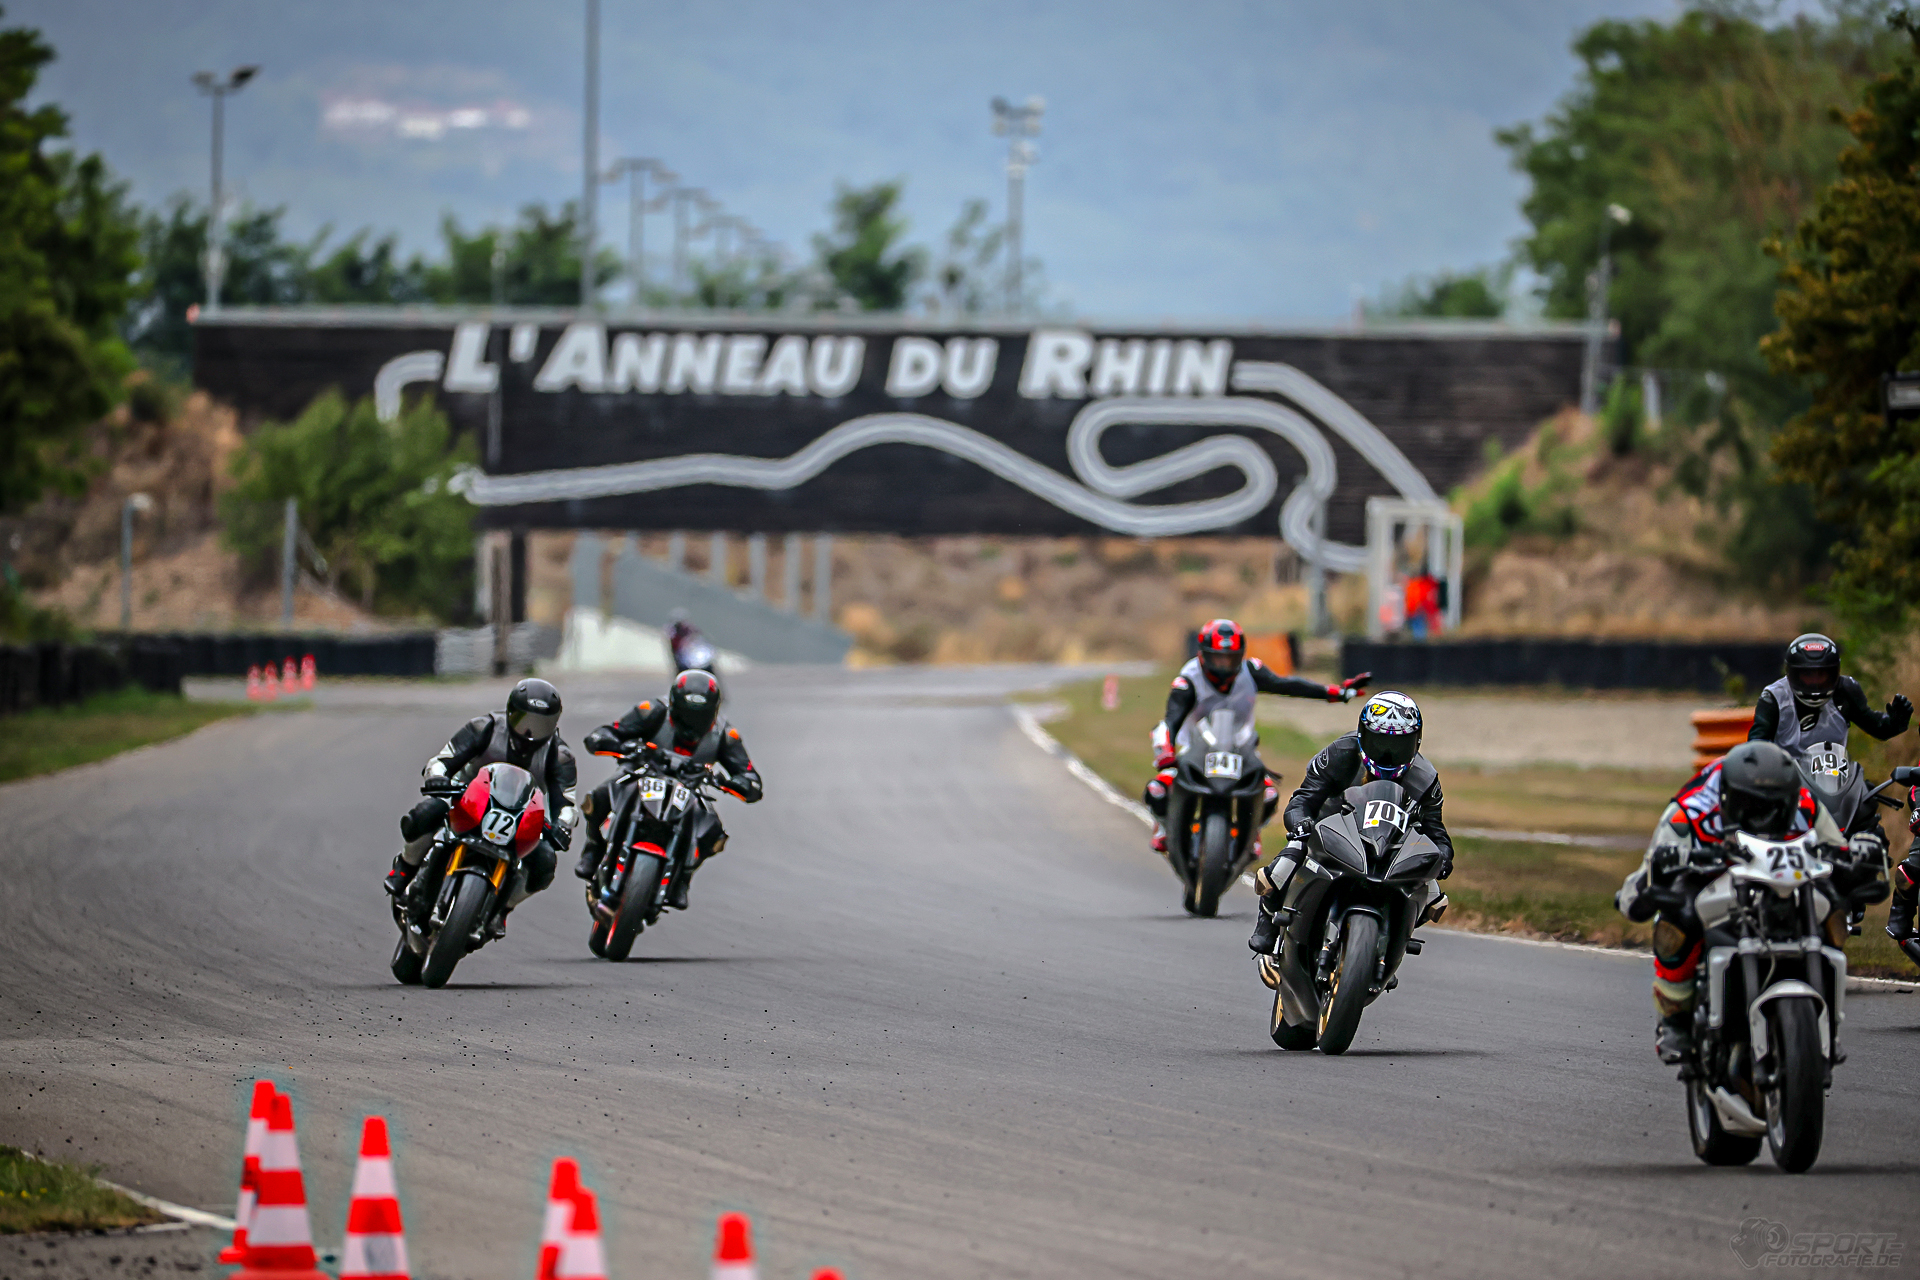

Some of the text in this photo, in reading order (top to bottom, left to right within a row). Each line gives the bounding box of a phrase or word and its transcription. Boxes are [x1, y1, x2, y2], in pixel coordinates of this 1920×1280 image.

[444, 322, 1233, 398] L'ANNEAU DU RHIN
[1812, 753, 1848, 777] 492
[487, 811, 514, 837] 72
[1766, 846, 1804, 872] 25
